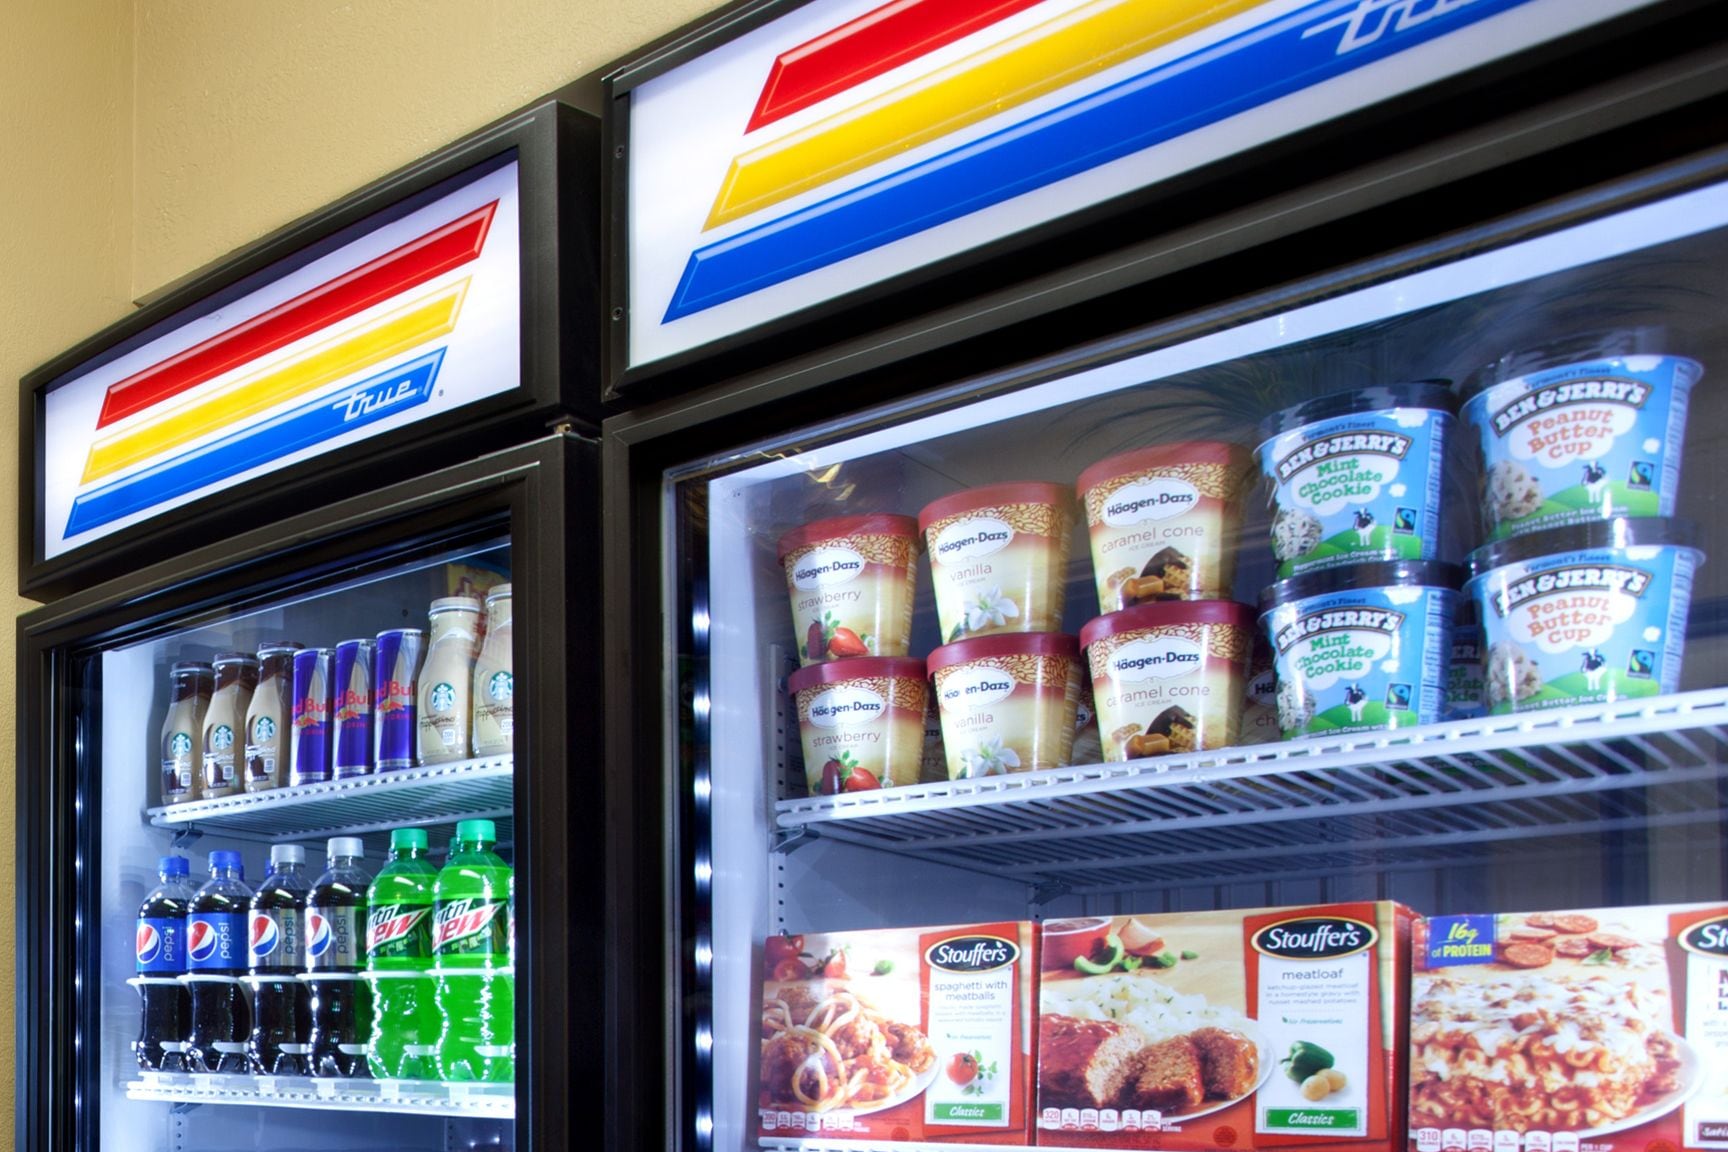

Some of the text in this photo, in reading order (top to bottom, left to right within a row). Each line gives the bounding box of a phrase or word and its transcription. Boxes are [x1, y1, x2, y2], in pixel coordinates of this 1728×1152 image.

[333, 380, 417, 421] true
[1527, 408, 1615, 436] Peanut
[1528, 425, 1613, 454] Butter
[1548, 440, 1592, 461] Cup
[1317, 457, 1360, 478] Mint
[1299, 470, 1383, 498] Chocolate
[1311, 484, 1372, 505] Cookie
[1107, 492, 1194, 517] Häagen-Dazs
[938, 528, 1009, 556] Häagen-Dazs
[1101, 524, 1204, 554] caramel cone
[795, 560, 860, 582] Häagen-Dazs
[950, 562, 993, 582] vanilla
[797, 589, 862, 612] strawberry
[1527, 595, 1611, 620] Peanut
[1527, 611, 1612, 637] Butter
[1310, 633, 1351, 651] Mint
[1548, 627, 1592, 644] Cup
[1113, 651, 1200, 671] Häagen-Dazs
[1305, 659, 1364, 679] Cookie
[1168, 683, 1210, 698] cone
[954, 712, 994, 729] vanilla
[813, 730, 881, 748] strawberry
[219, 922, 232, 961] pepsi
[284, 915, 295, 957] pepsi
[338, 914, 350, 955] pepsi
[1266, 923, 1361, 952] Stouffer's
[1448, 922, 1479, 943] 16g
[936, 941, 1008, 967] Stouffer's
[1443, 944, 1493, 958] PROTEIN
[1282, 968, 1344, 980] meatloaf
[935, 980, 1008, 992] spaghetti with
[945, 990, 996, 1001] meatballs
[949, 1105, 985, 1117] Classics
[1288, 1112, 1335, 1125] Classics
